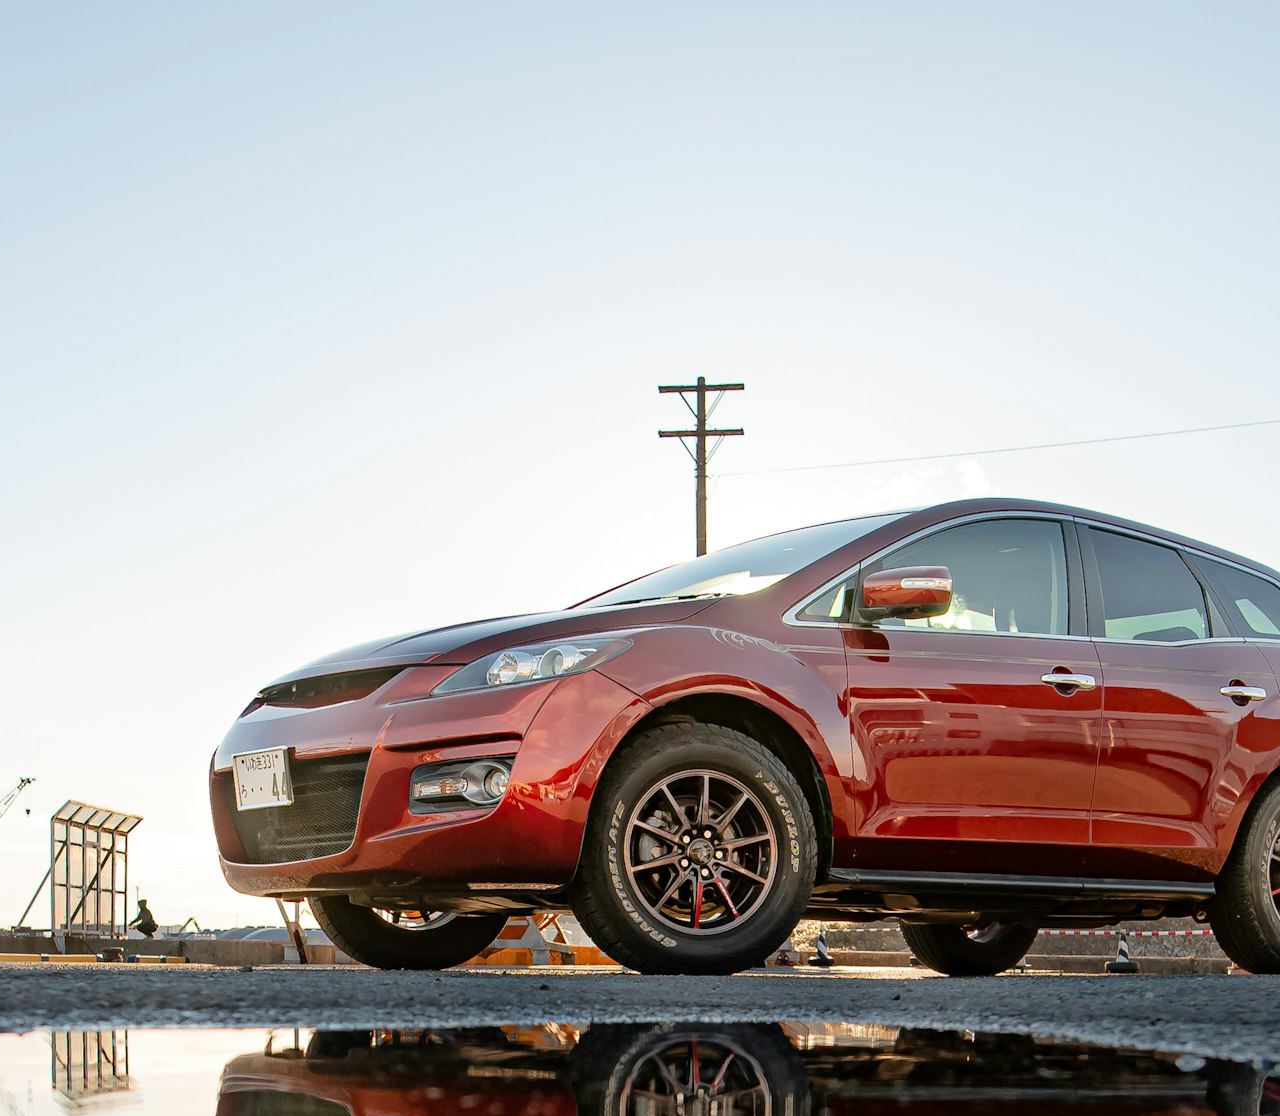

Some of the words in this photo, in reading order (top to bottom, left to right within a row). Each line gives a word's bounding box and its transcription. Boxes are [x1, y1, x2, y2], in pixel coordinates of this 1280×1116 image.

[764, 780, 800, 873] DUNLOP
[1261, 820, 1277, 904] DUNLOP
[607, 844, 678, 948] GRANDTREK
